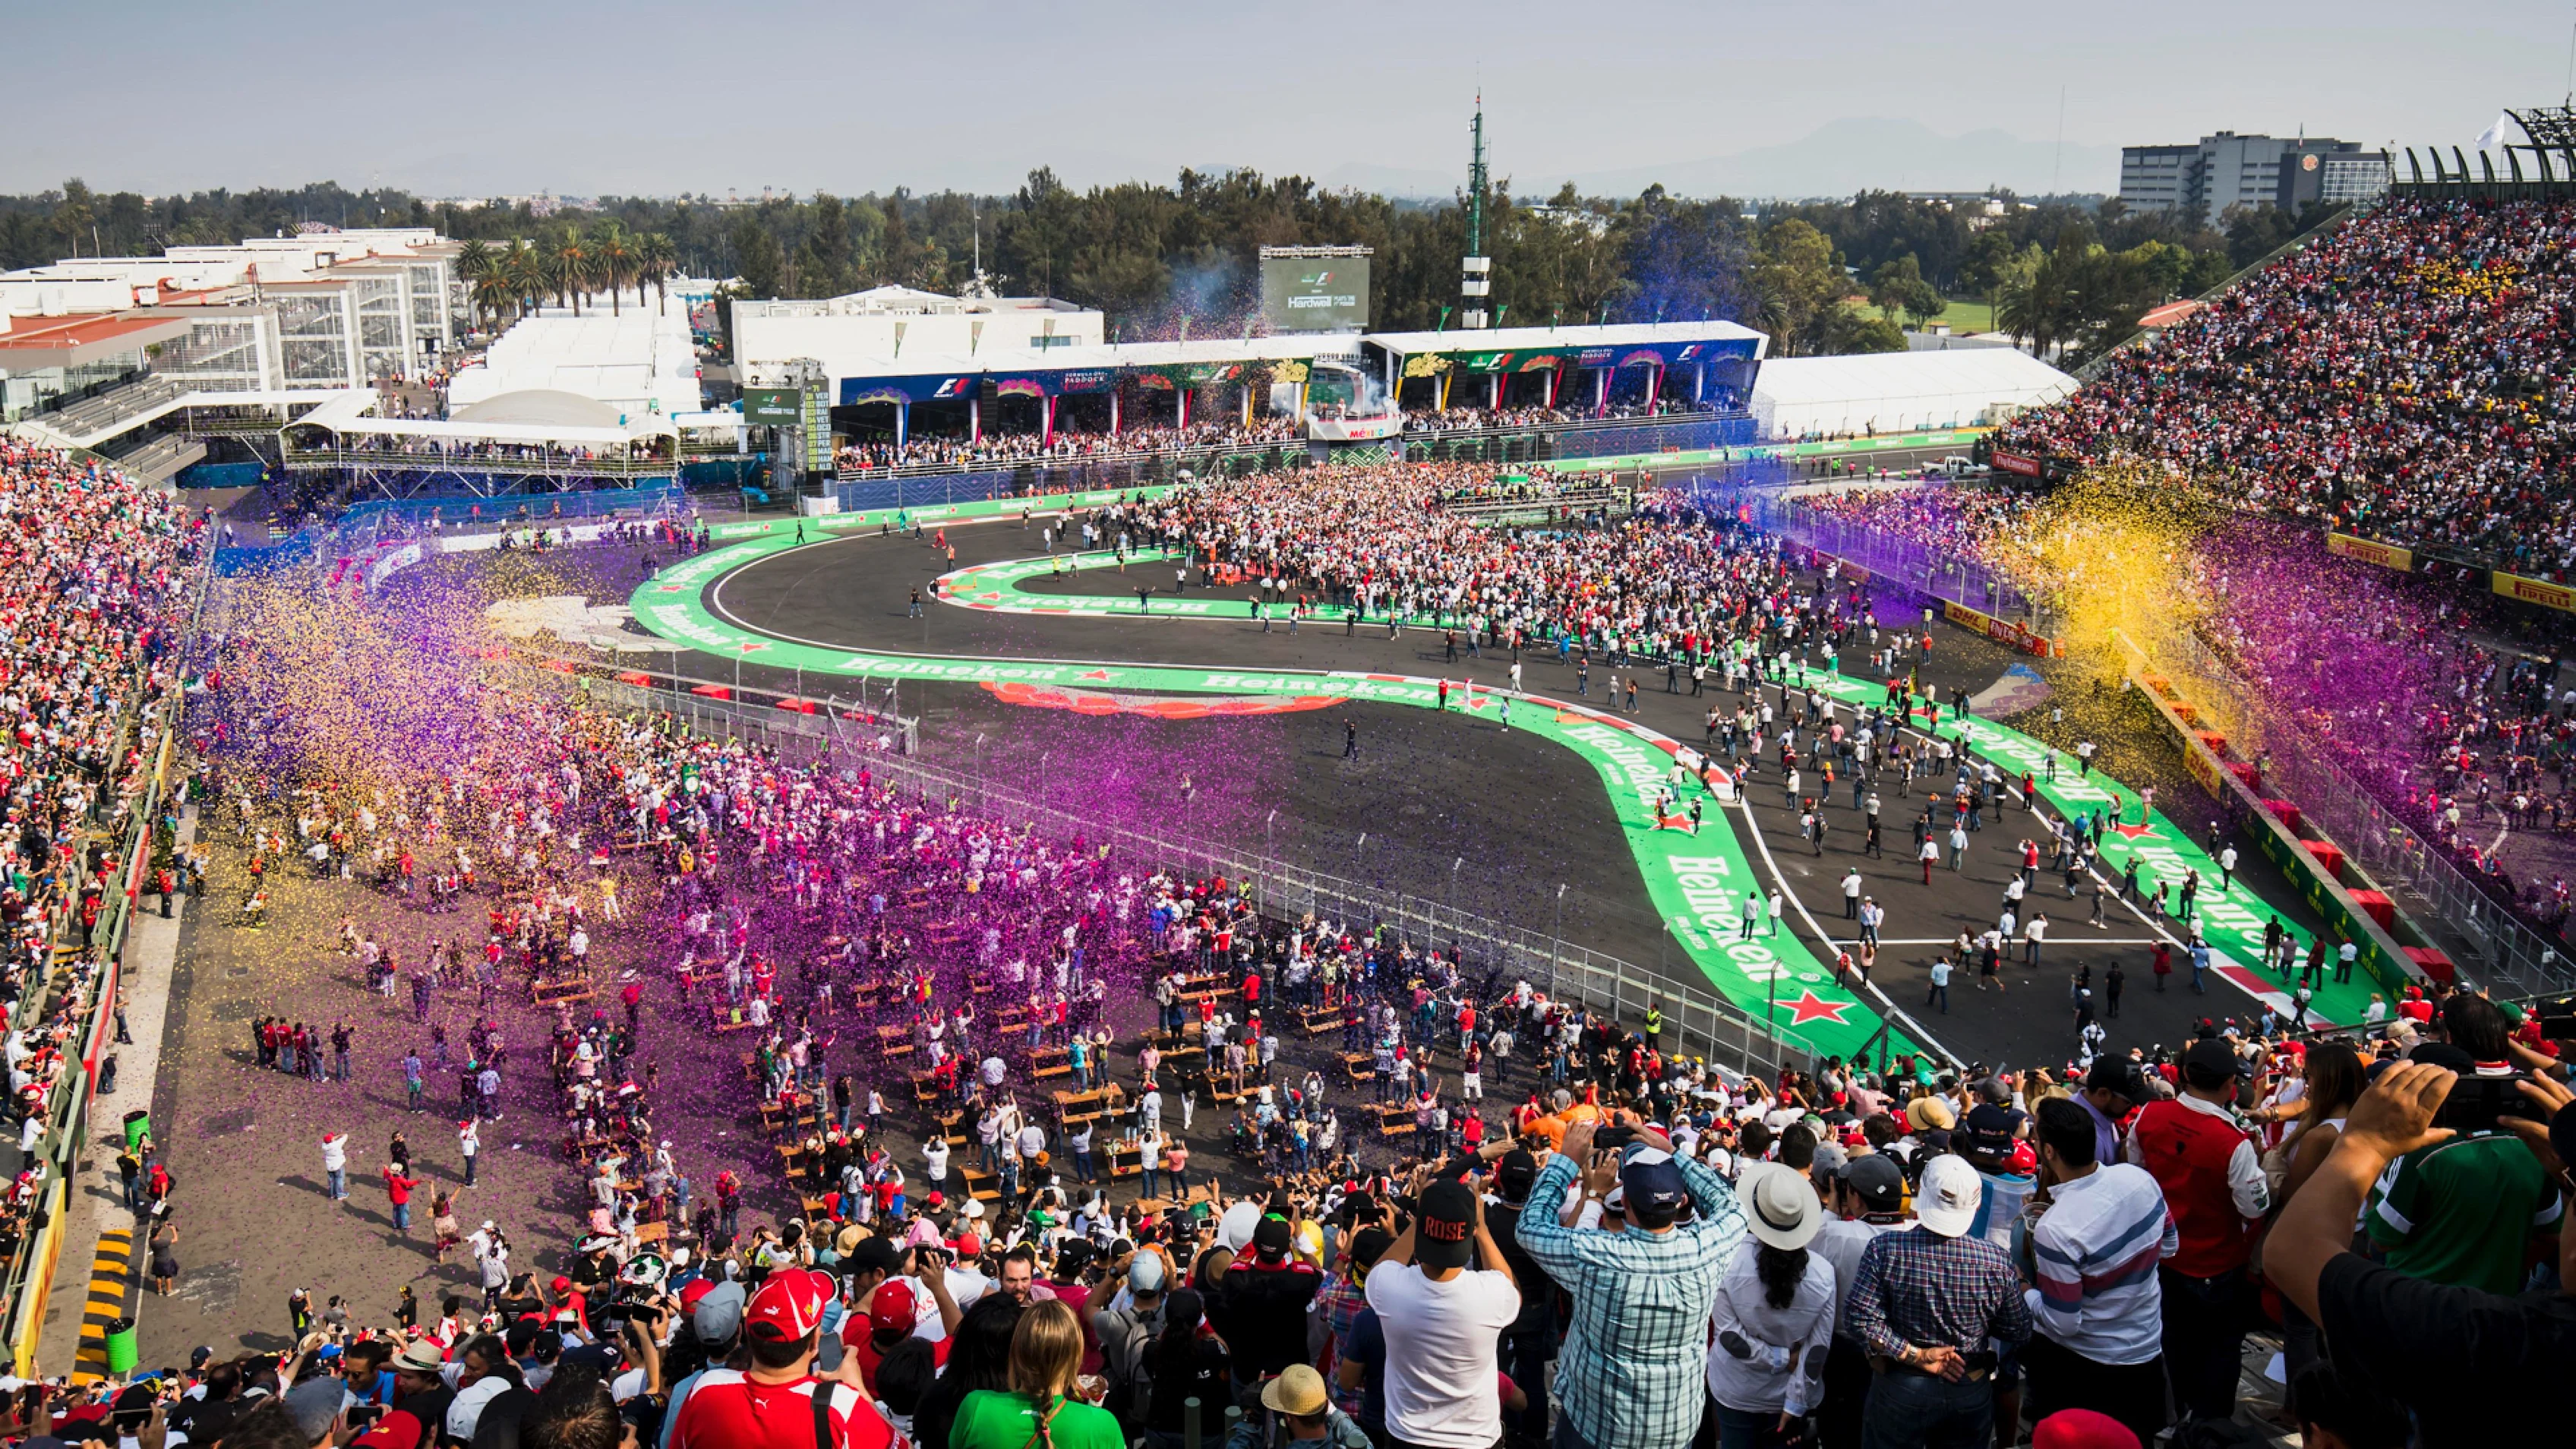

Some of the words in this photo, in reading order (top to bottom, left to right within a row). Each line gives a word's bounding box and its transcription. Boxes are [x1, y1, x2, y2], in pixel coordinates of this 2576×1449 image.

[2514, 580, 2570, 607] PIRELLI
[835, 657, 1060, 680] Heineken
[1200, 674, 1439, 701] Heineken
[1668, 854, 1793, 983] Heineken
[2360, 952, 2382, 983] ROLEX
[1424, 1215, 1466, 1242] ROSE
